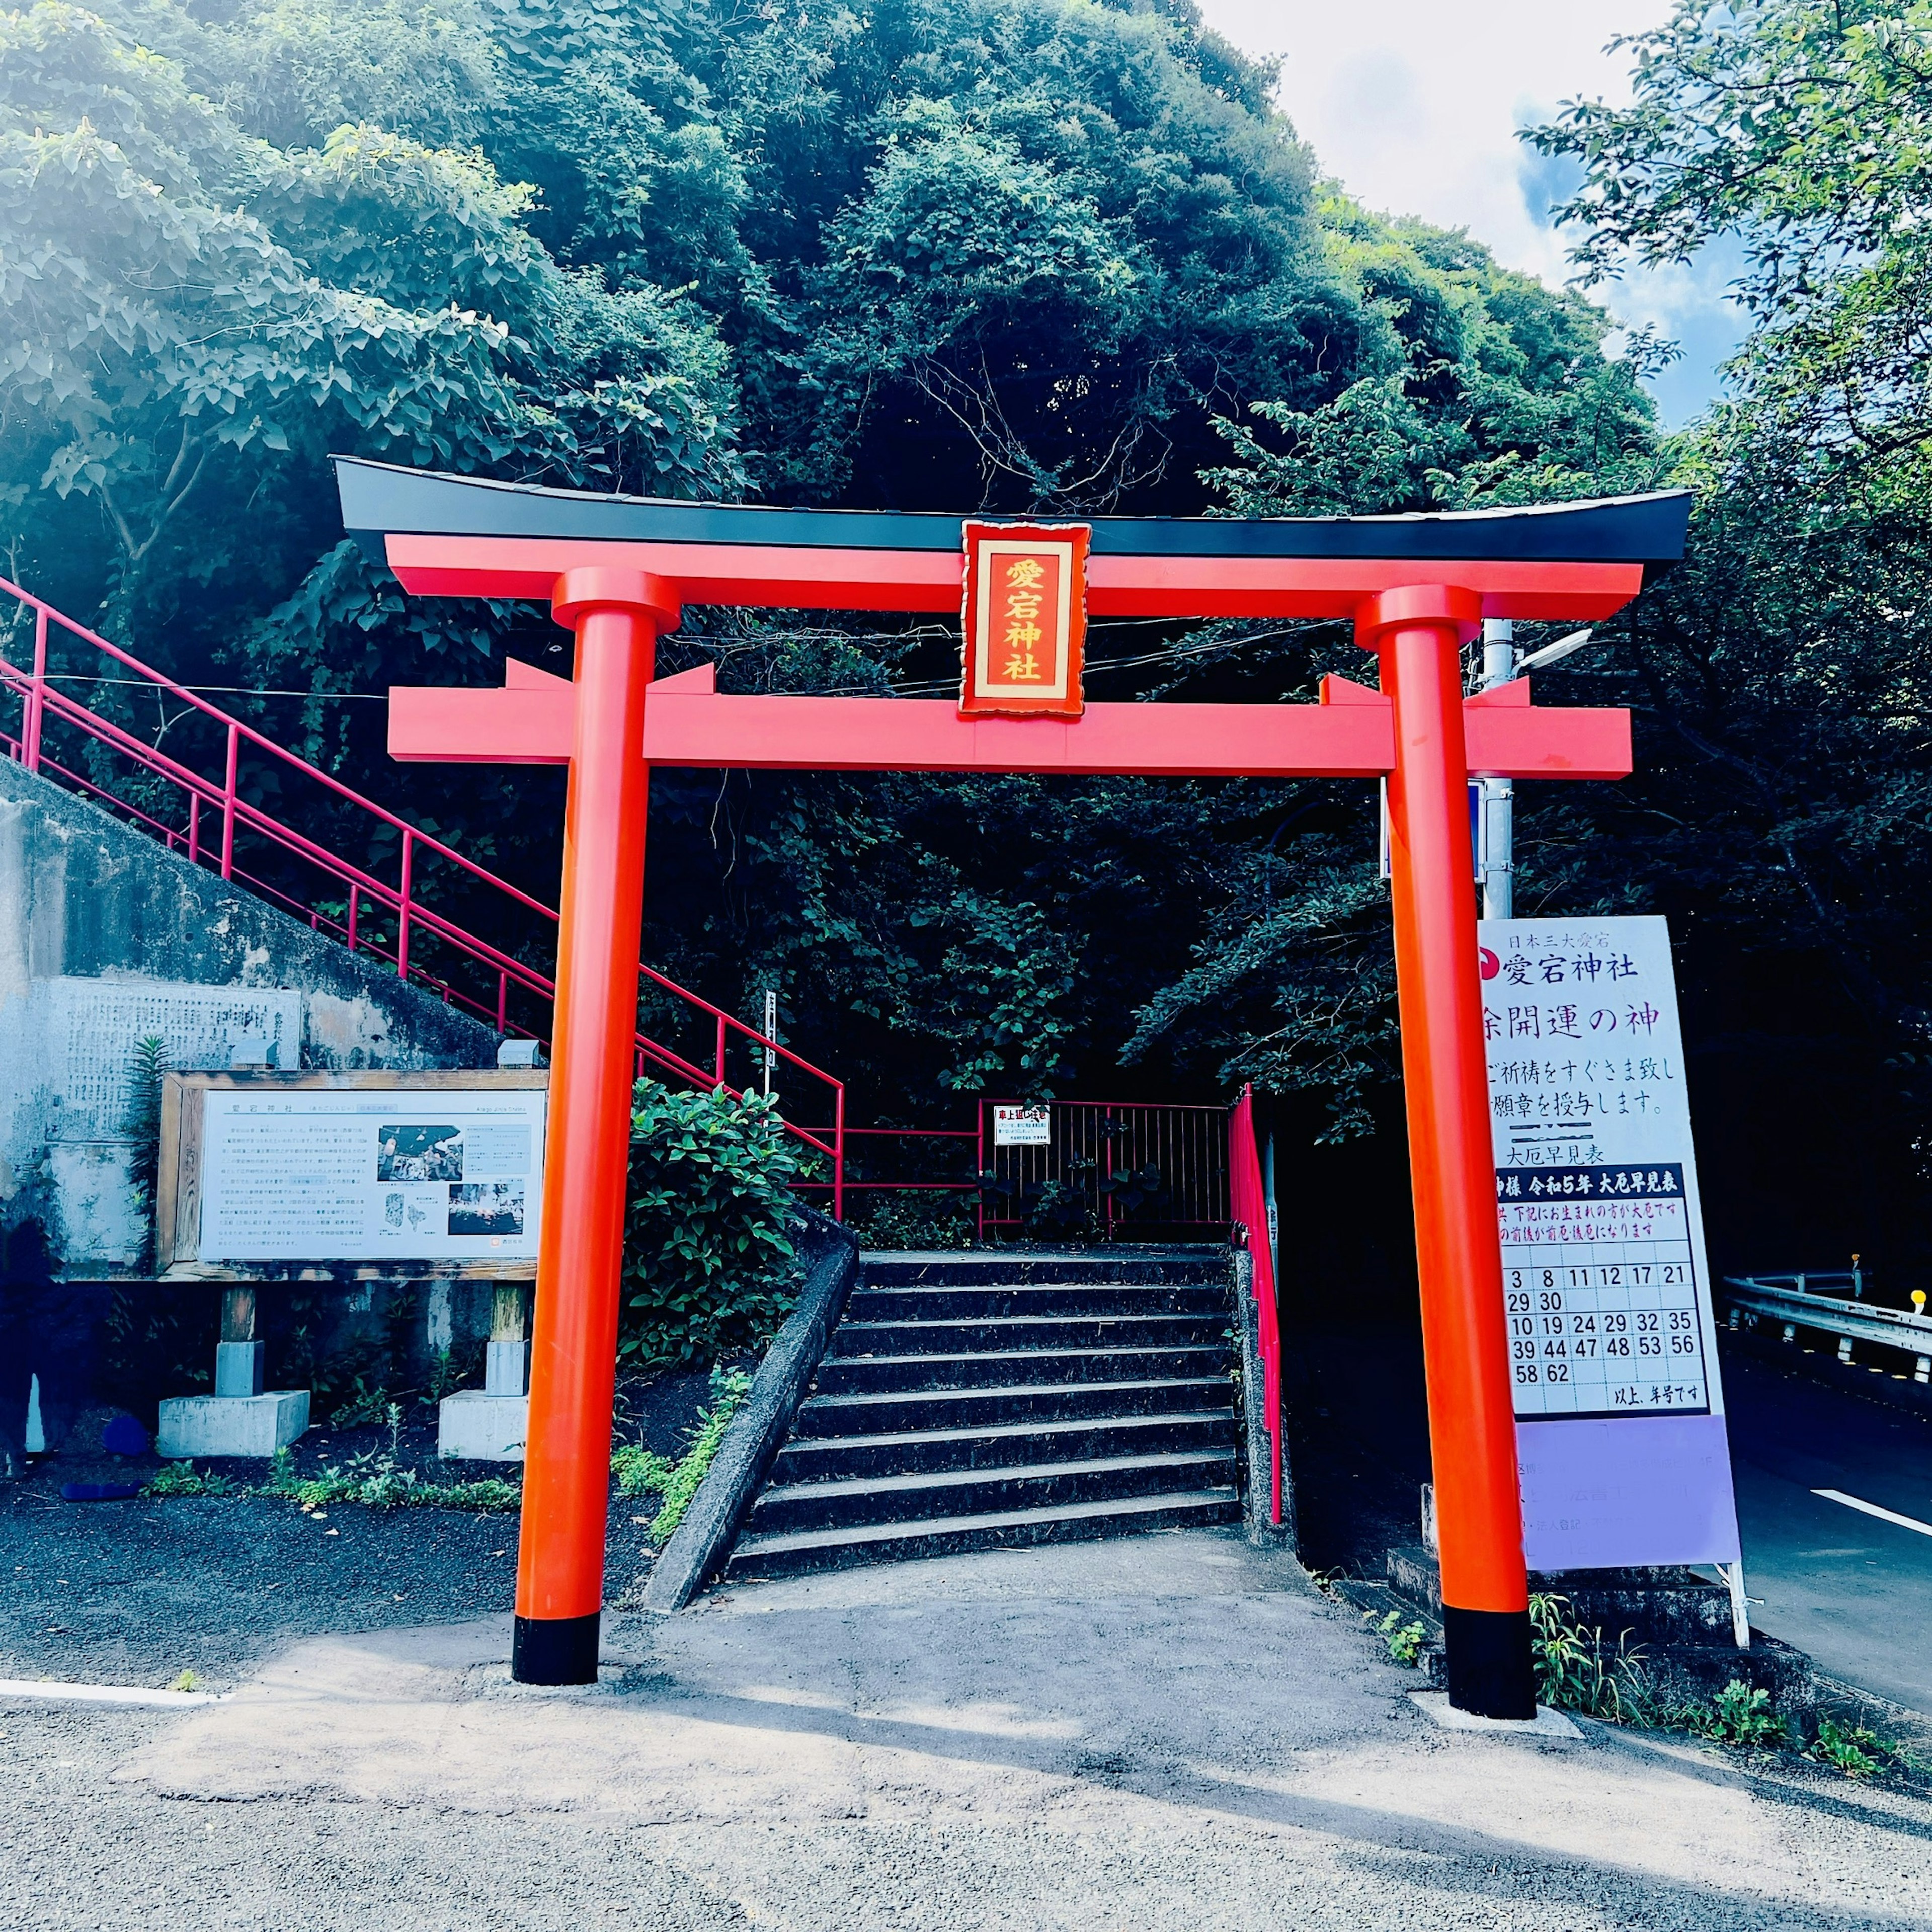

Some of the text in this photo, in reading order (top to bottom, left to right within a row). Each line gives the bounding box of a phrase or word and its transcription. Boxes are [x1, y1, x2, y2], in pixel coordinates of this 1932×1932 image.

[1002, 558, 1045, 680] 愛宕神社
[1509, 931, 1610, 948] 日本三大愛宕
[1502, 952, 1639, 986] 愛宕神社
[1491, 1089, 1662, 1118] 願章を授与します。
[1507, 1144, 1604, 1165] 大厄早見表
[1528, 1175, 1593, 1196] 令和5年
[1599, 1171, 1678, 1194] 大厄早見表
[1512, 1265, 1684, 1289] 3 8 11 12 17 21
[1508, 1293, 1561, 1312] 29 30
[1513, 1313, 1691, 1335] 10 19 24 29 32 35
[1513, 1336, 1694, 1359] 39 44 47 48 53 56
[1516, 1365, 1568, 1383] 58 62
